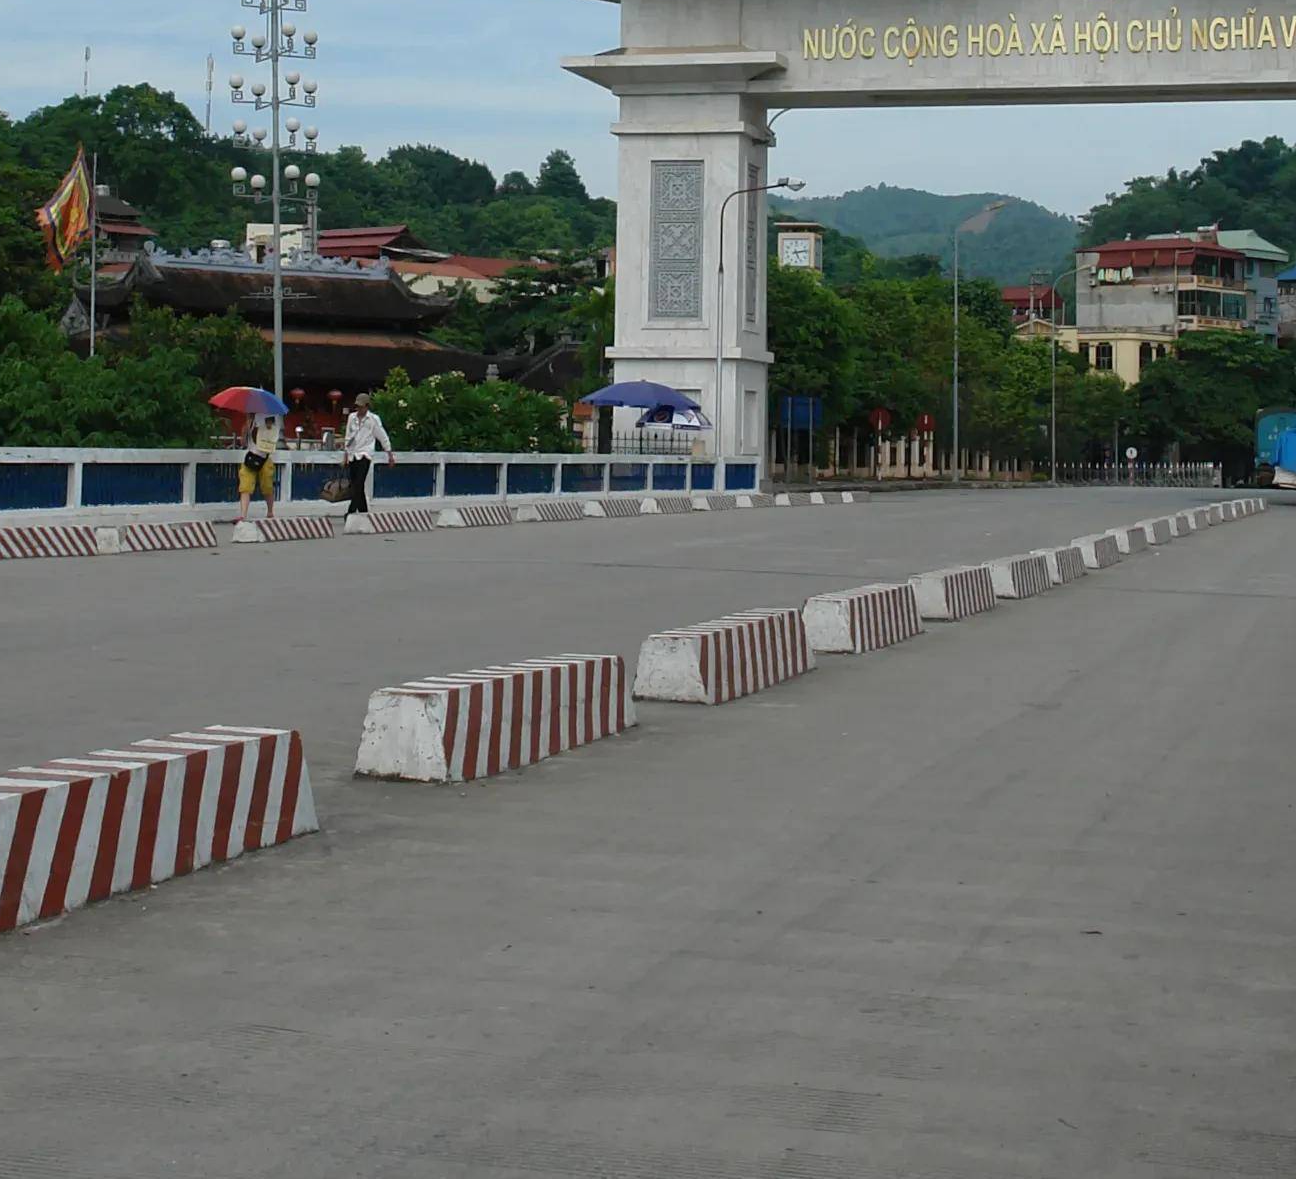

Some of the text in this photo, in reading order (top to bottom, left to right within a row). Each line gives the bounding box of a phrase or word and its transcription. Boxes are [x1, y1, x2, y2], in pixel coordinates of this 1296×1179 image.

[803, 18, 876, 60] NƯỚC
[883, 17, 960, 66] CỘNG
[967, 13, 1025, 57] HOÀ
[1029, 14, 1068, 55] XÃ
[1074, 11, 1119, 62] HỘI
[1126, 6, 1182, 53] CHỦ
[1191, 8, 1277, 51] NGHĨA
